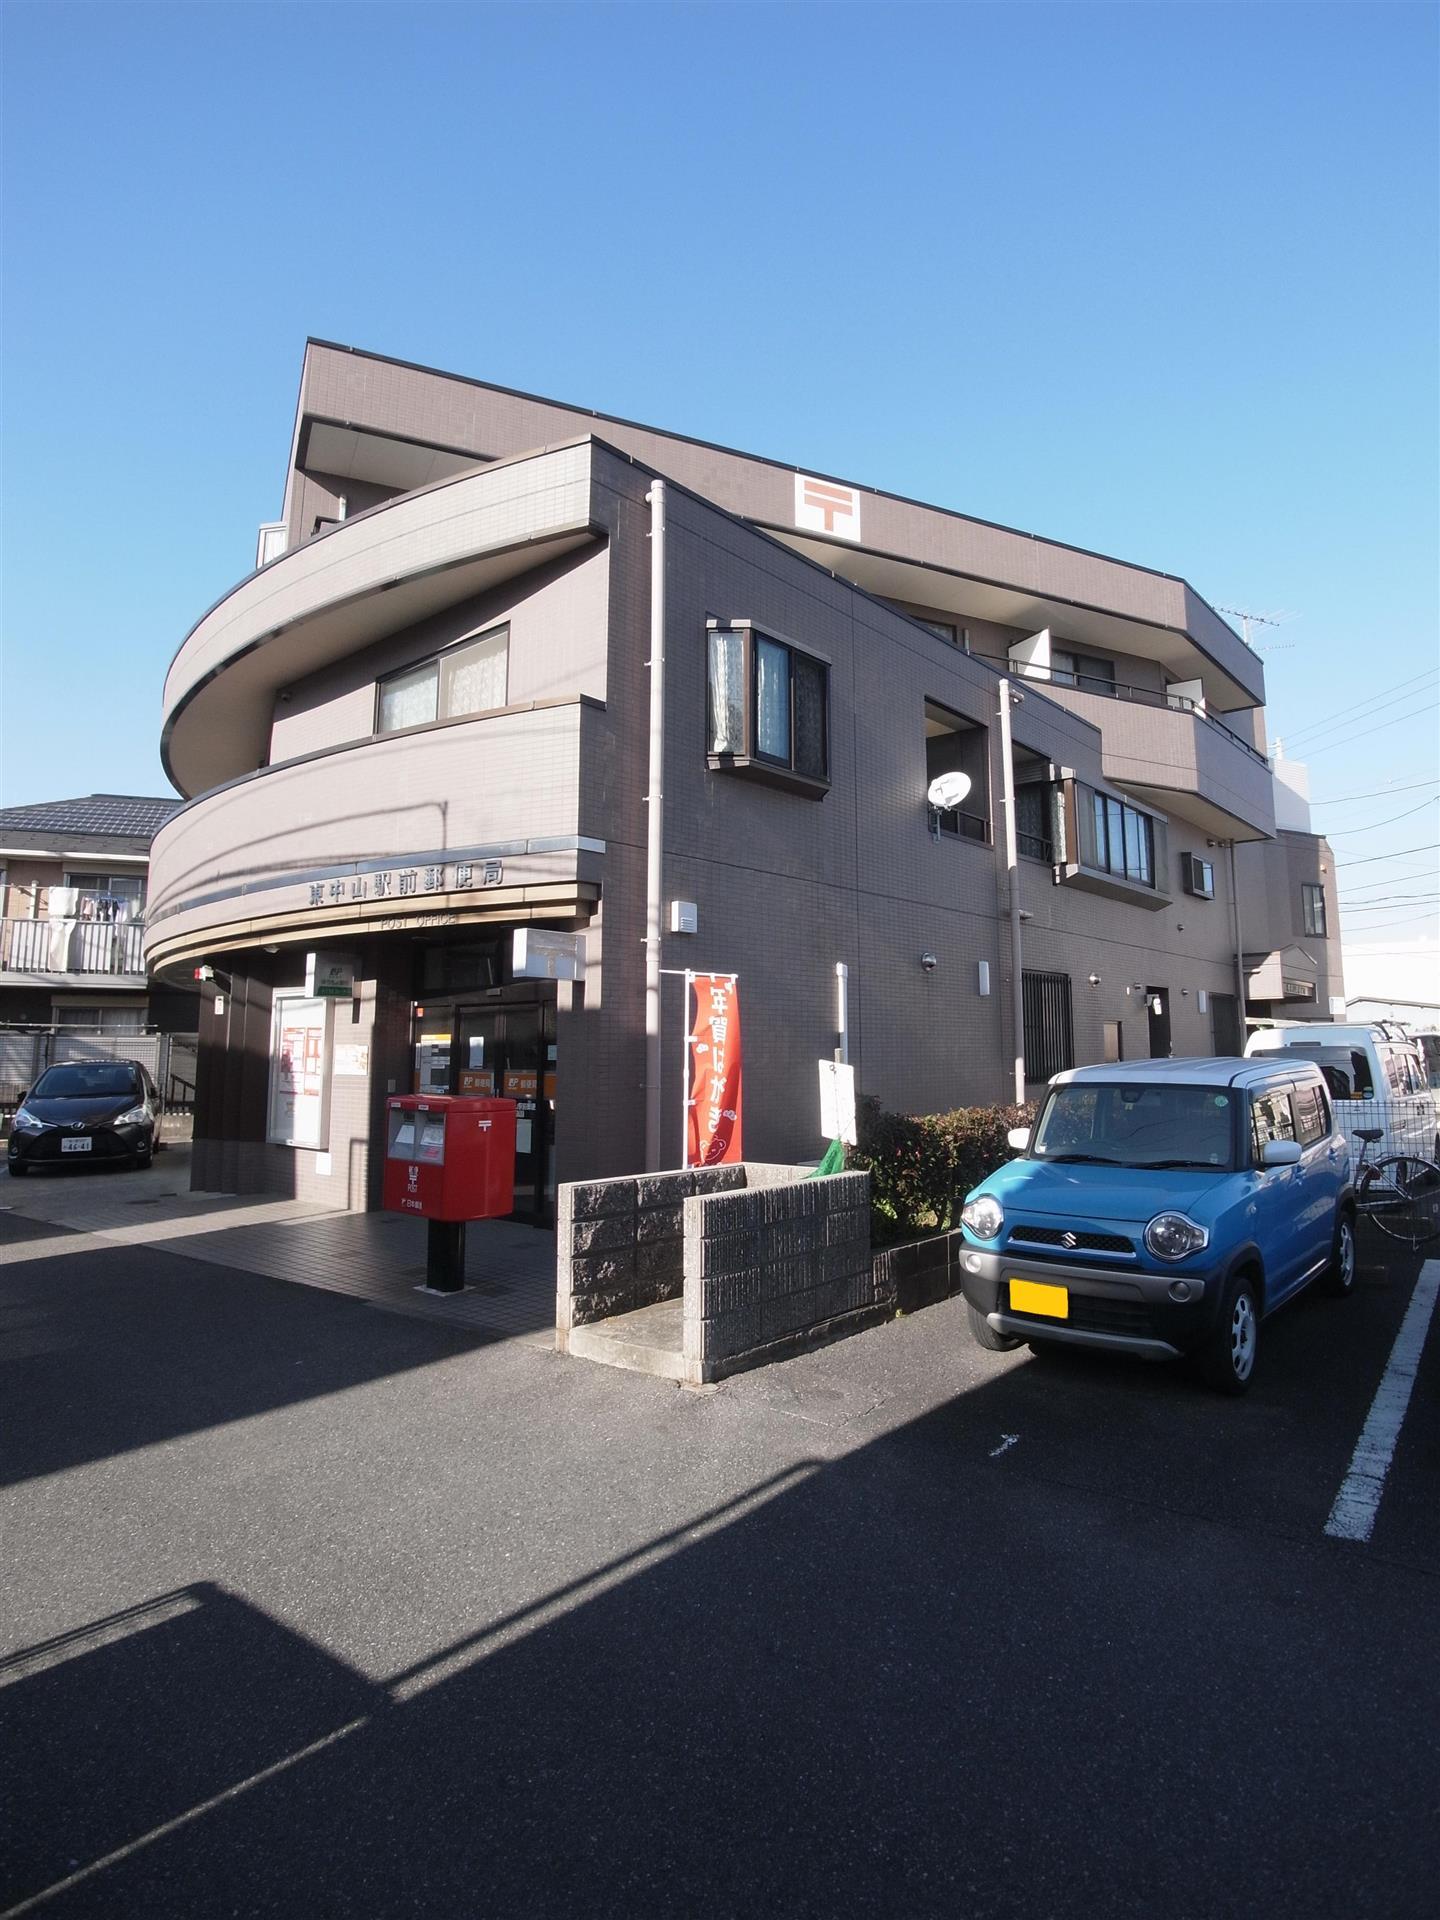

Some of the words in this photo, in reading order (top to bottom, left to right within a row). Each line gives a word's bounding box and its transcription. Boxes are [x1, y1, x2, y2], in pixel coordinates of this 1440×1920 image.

[309, 859, 505, 906] 東中山駅前郵便局
[380, 918, 408, 931] POST
[416, 914, 457, 928] OFFICE
[708, 986, 728, 1133] 年賀はがき
